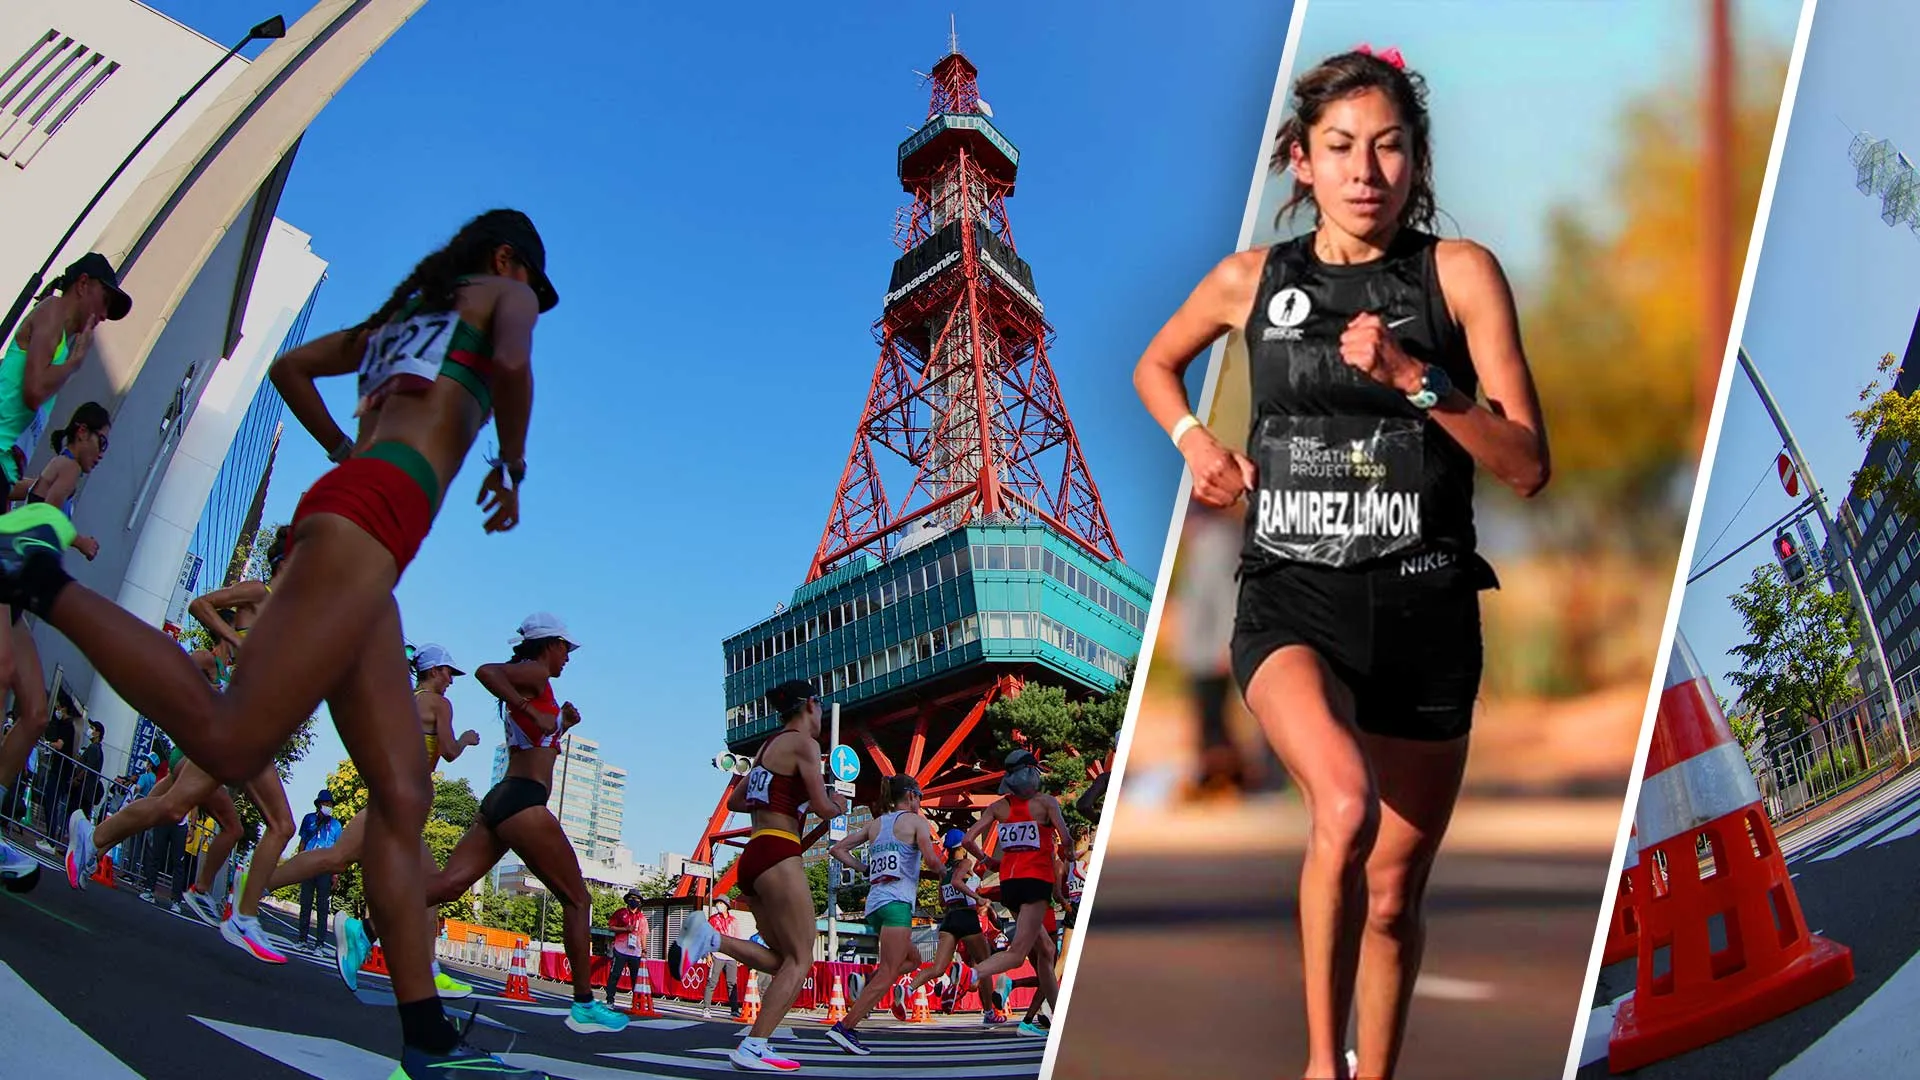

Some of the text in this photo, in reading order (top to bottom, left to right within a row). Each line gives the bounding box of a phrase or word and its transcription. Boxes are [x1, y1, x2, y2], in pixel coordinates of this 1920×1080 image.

[883, 250, 961, 308] Panasonic
[980, 247, 1044, 315] Panasonic
[1290, 462, 1387, 478] PROJECT 2020
[1256, 489, 1419, 537] RAMIREZ LIMON
[1400, 551, 1449, 577] NIKE
[1000, 824, 1037, 842] 2673
